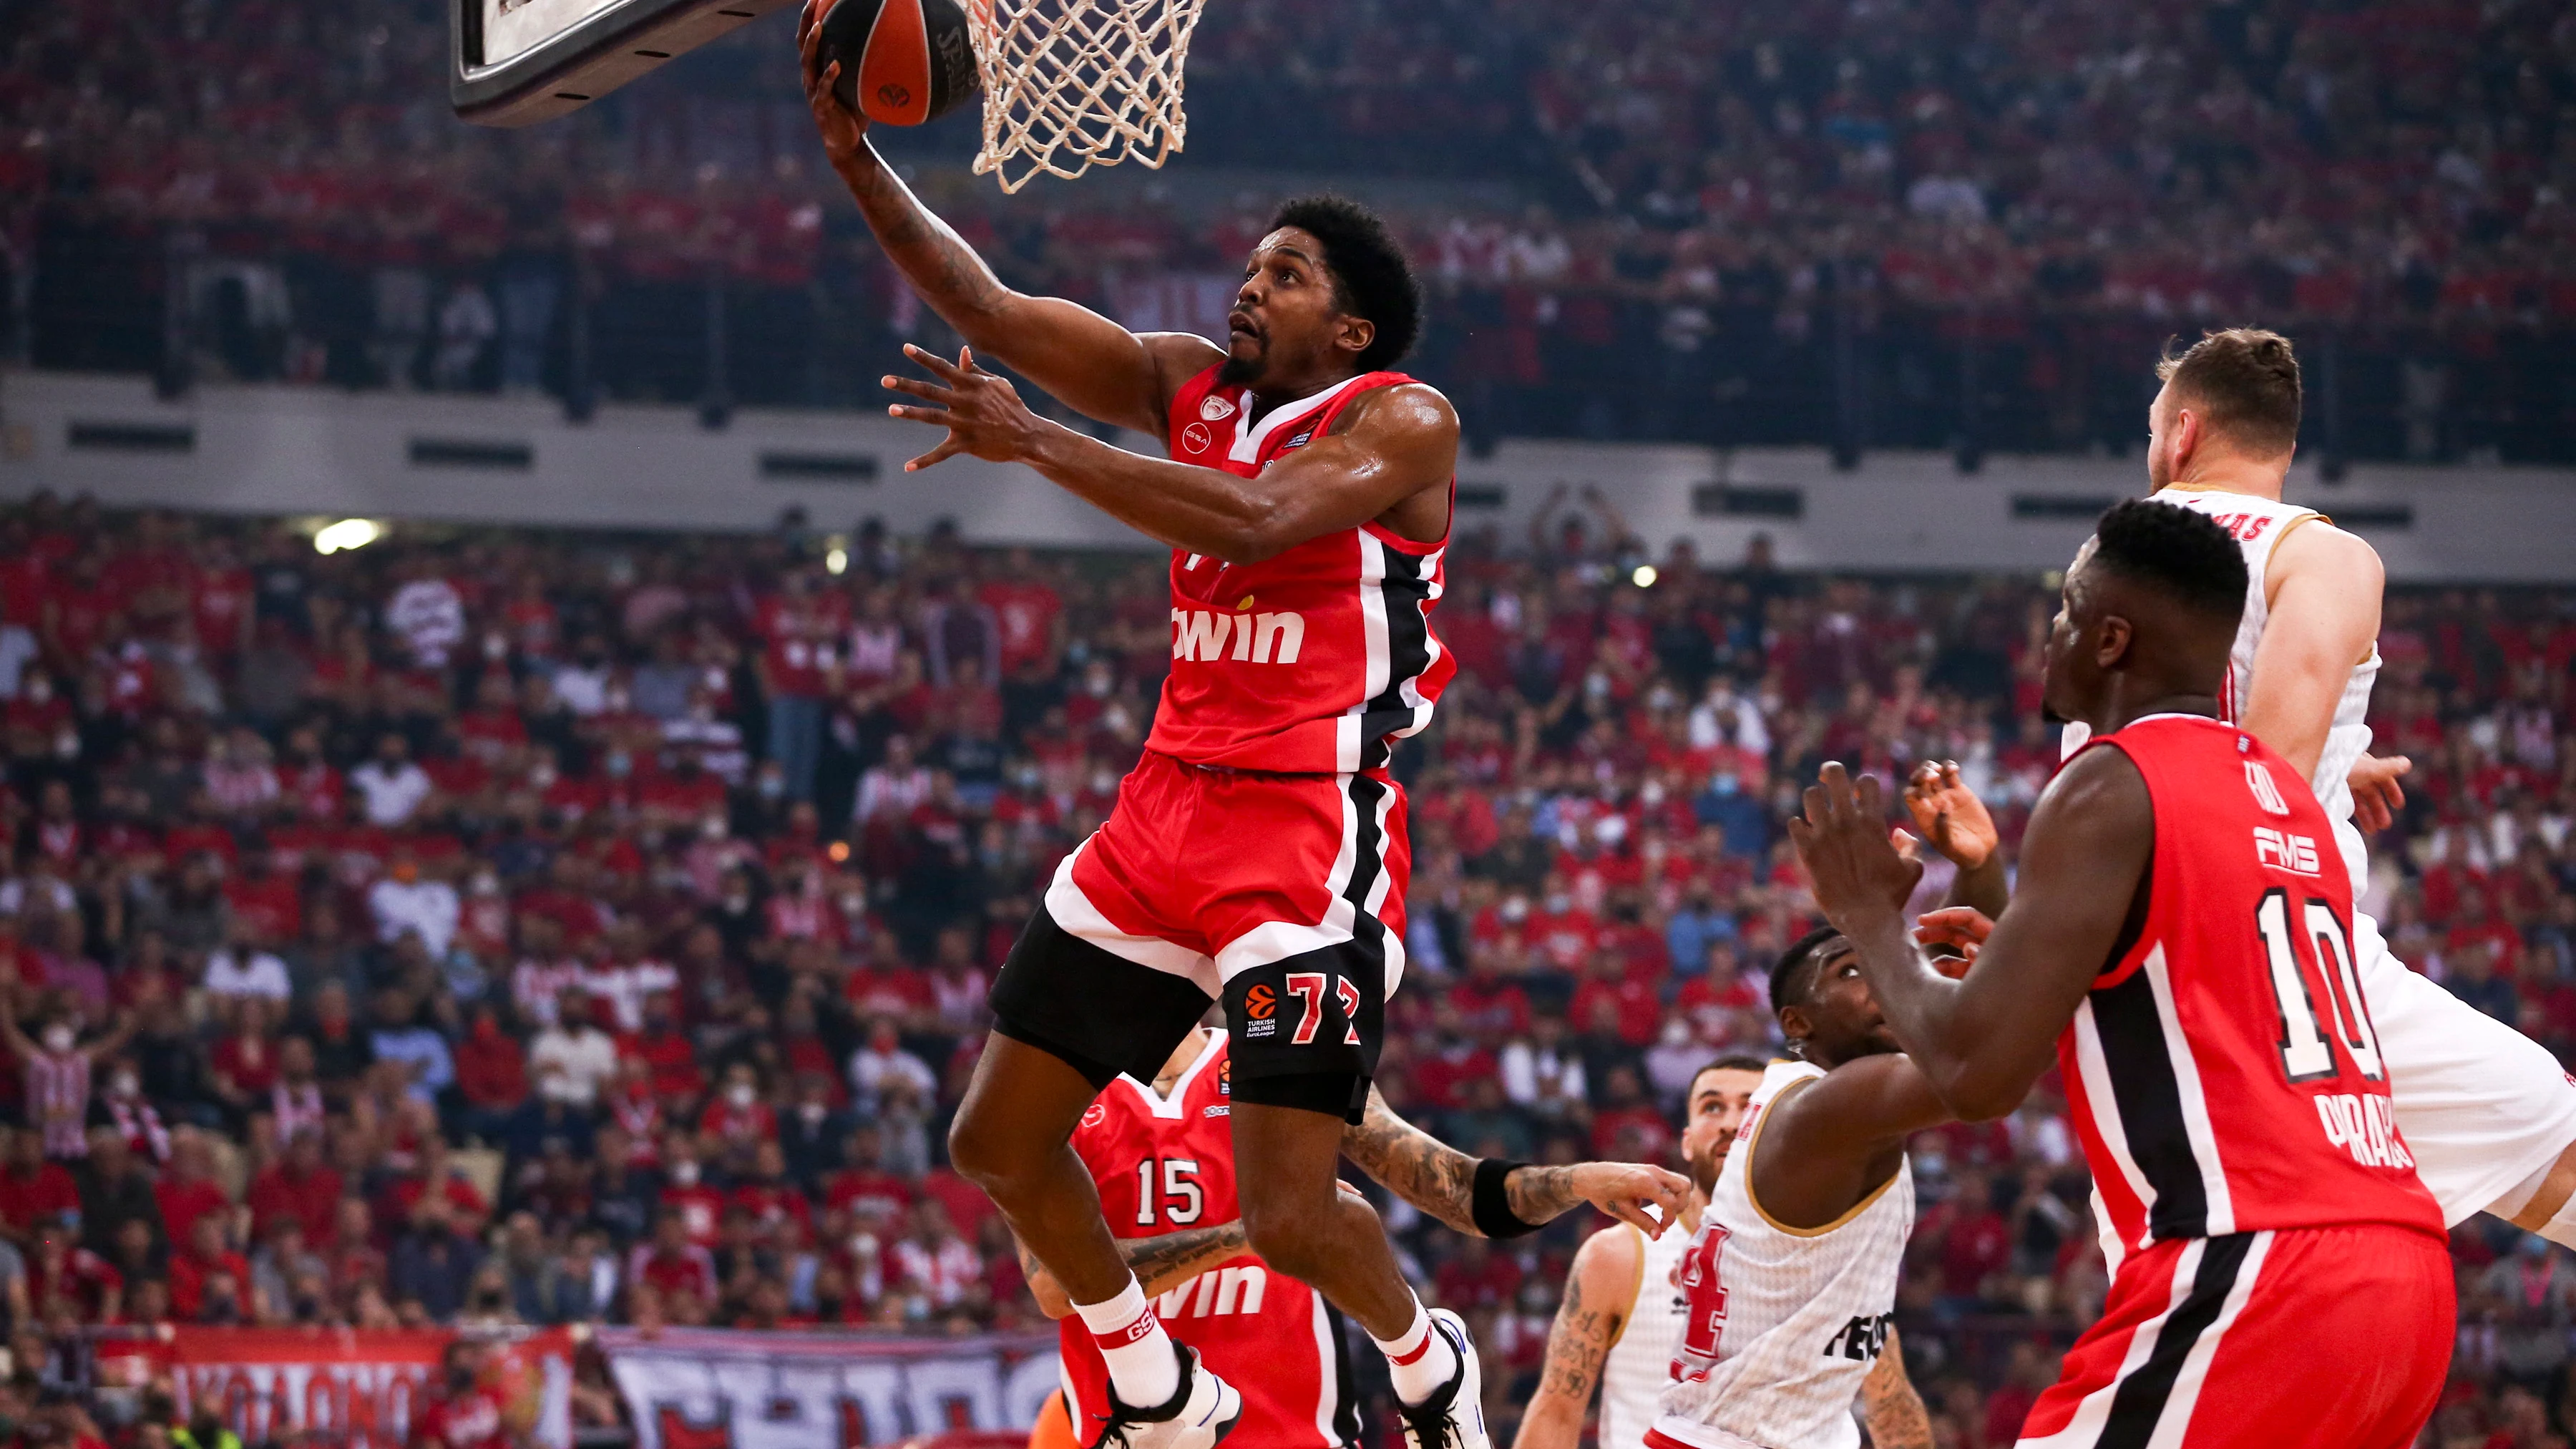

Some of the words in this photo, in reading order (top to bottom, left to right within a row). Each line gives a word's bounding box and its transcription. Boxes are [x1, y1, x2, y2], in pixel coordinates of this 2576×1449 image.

[1186, 430, 1207, 445] GSA
[2253, 826, 2321, 873] FMS
[2255, 886, 2385, 1083] 10
[1247, 1018, 1275, 1027] TURKISH
[1247, 1024, 1275, 1033] AIRLINES
[1136, 1157, 1204, 1226] 15
[1127, 1309, 1155, 1342] GS
